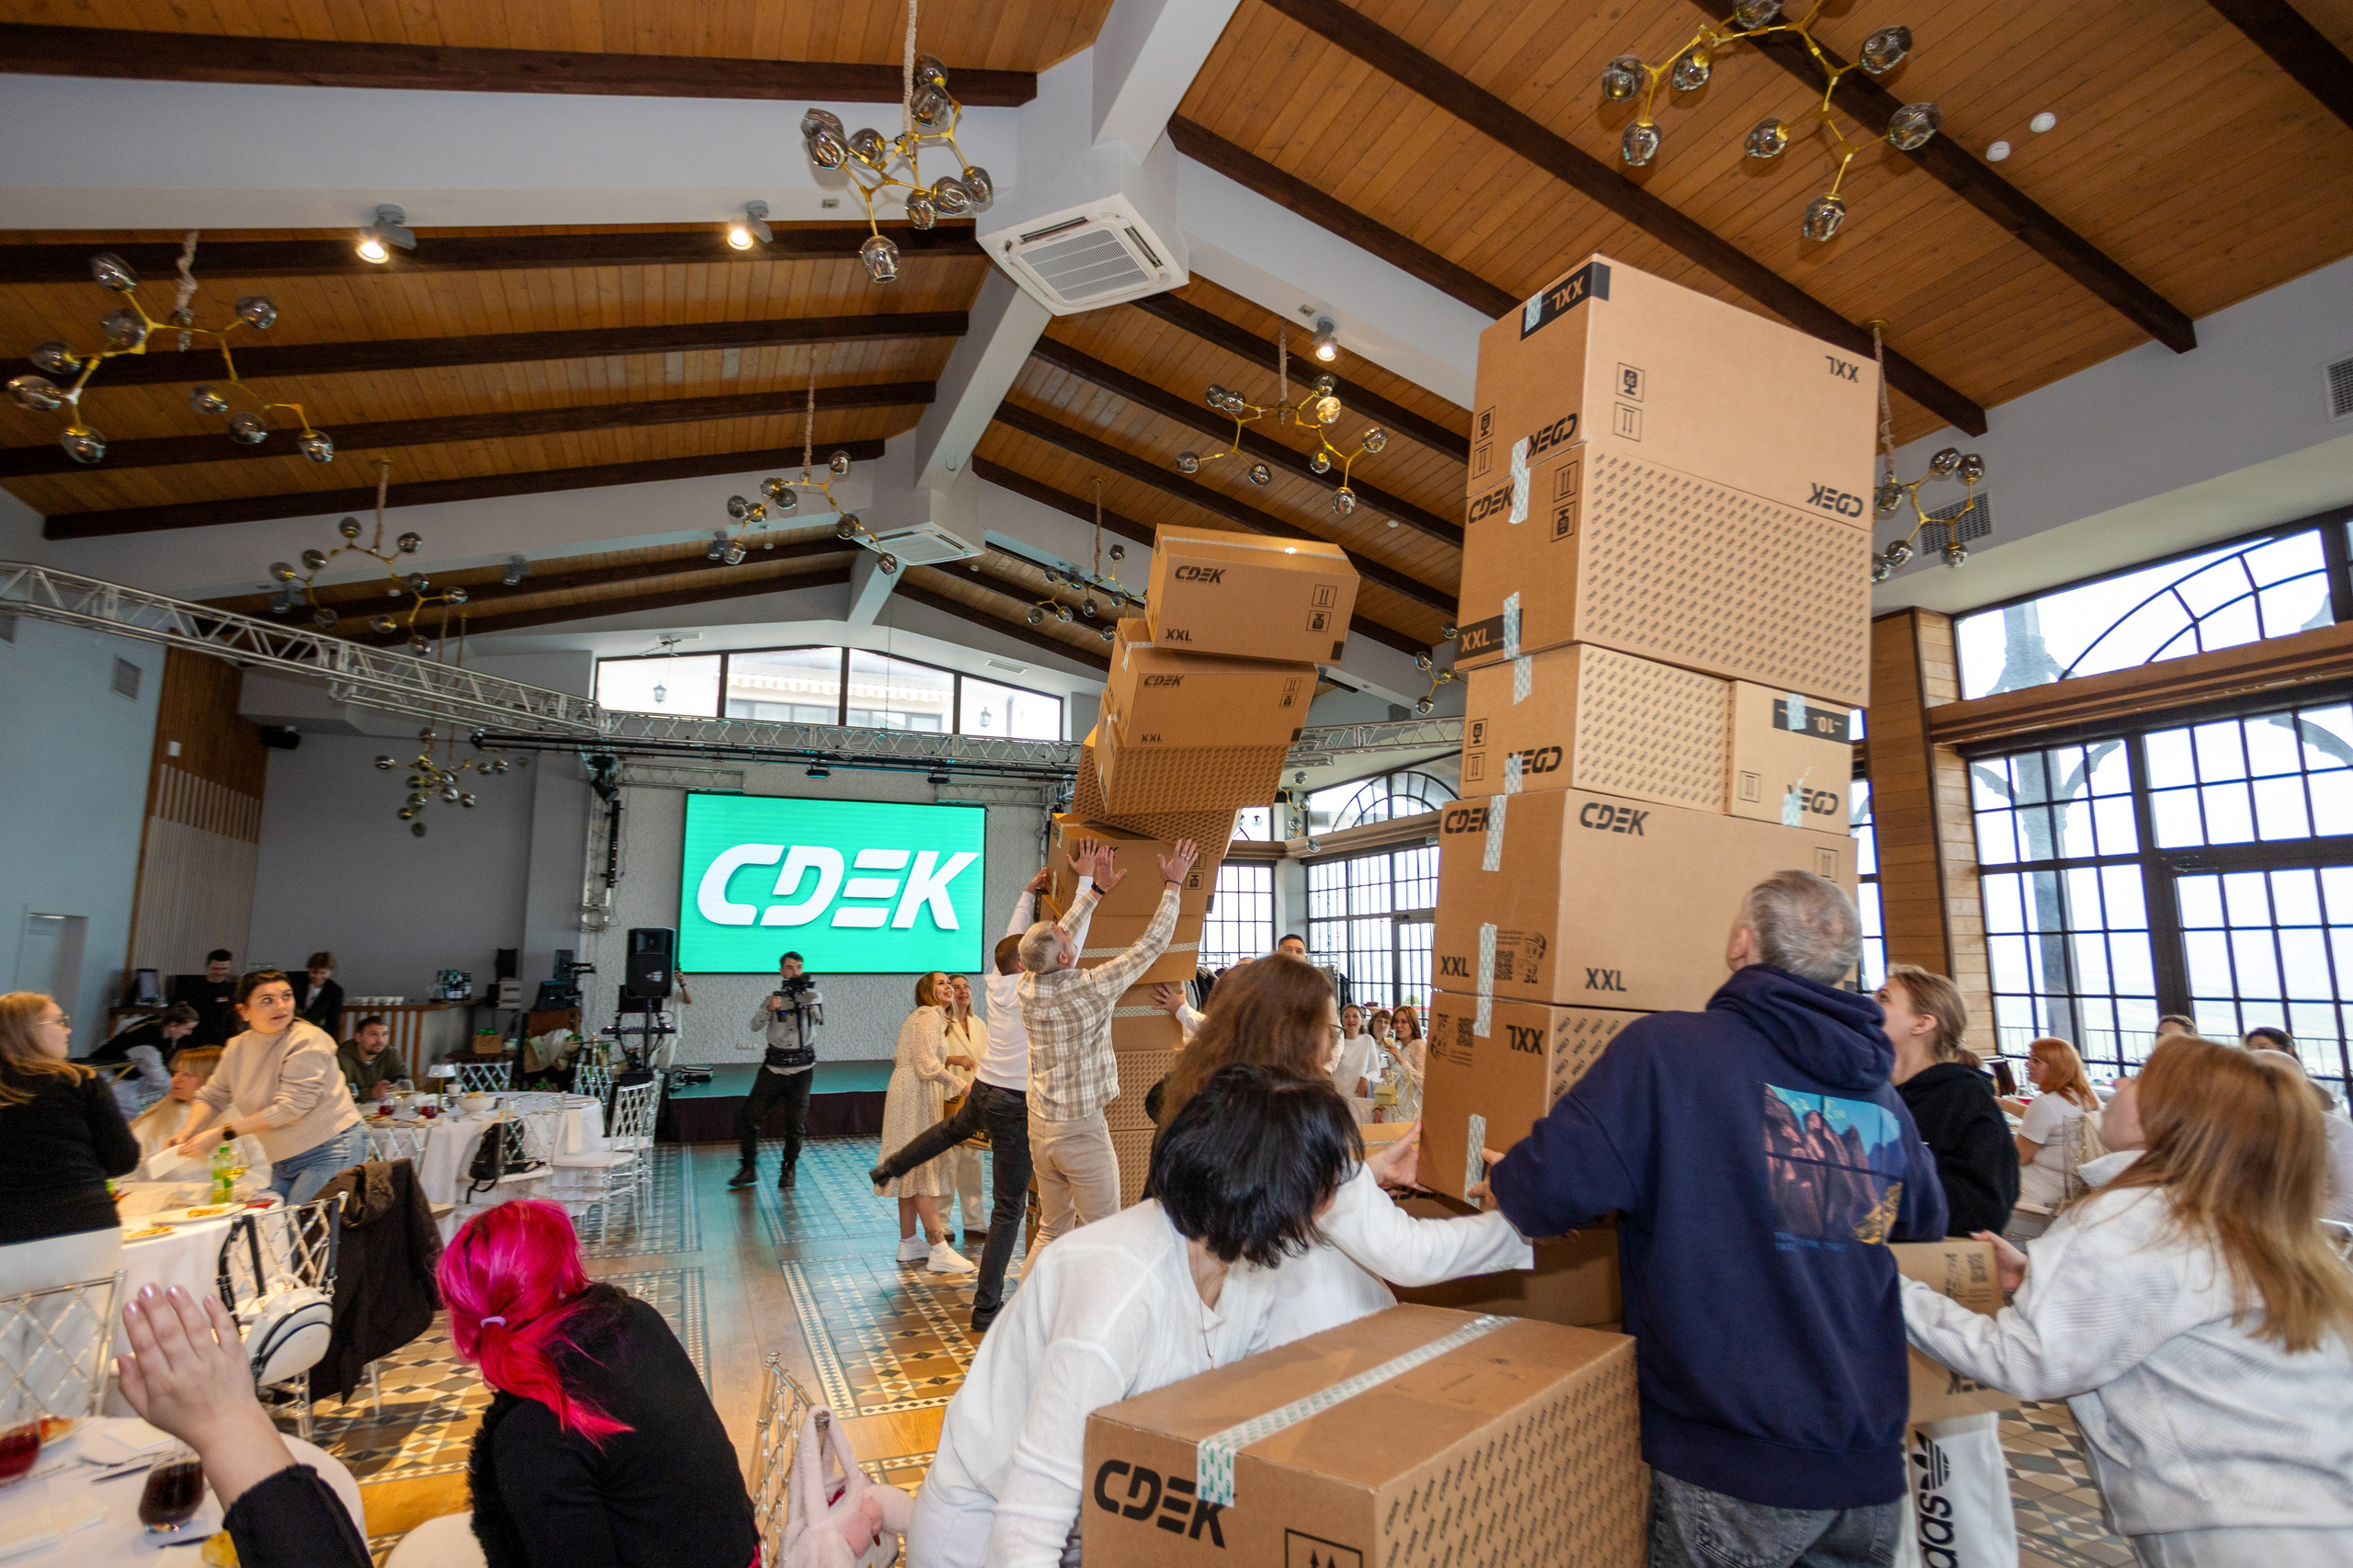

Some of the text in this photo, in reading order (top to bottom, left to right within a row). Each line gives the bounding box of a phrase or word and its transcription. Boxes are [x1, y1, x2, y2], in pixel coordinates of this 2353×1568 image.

[1552, 276, 1584, 311] XXL
[1825, 356, 1859, 383] XXL
[1526, 413, 1577, 460] CDEK
[1468, 483, 1515, 524] CDEK
[1806, 483, 1864, 517] CDEK
[1175, 565, 1226, 584] CDEK
[1165, 629, 1192, 642] XXL
[1461, 628, 1490, 653] XXL
[1143, 675, 1185, 687] CDEK
[1141, 733, 1163, 742] XXL
[1503, 745, 1563, 778] CDE
[1787, 784, 1838, 816] CDE
[1579, 802, 1651, 836] CDEK
[697, 843, 981, 930] CDEK
[1440, 956, 1470, 978] XXL
[1586, 967, 1628, 993] XXL
[1506, 1024, 1544, 1055] XXL
[1094, 1459, 1237, 1549] CDEK
